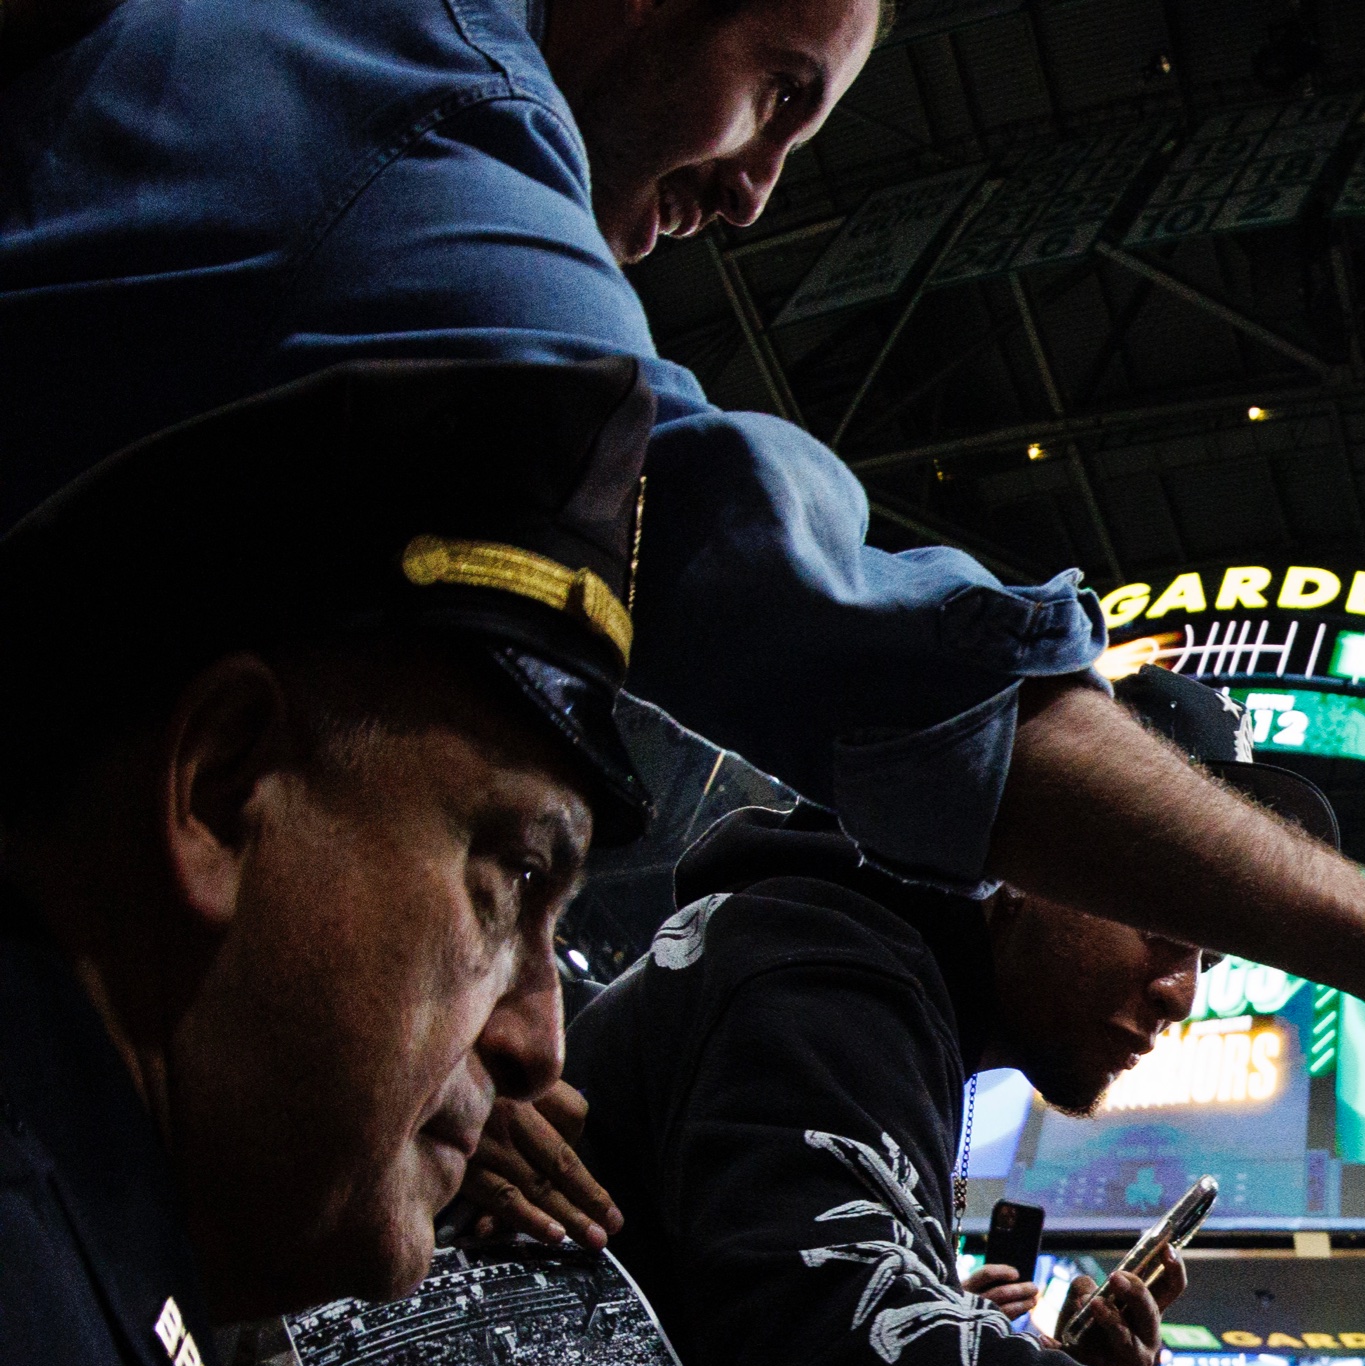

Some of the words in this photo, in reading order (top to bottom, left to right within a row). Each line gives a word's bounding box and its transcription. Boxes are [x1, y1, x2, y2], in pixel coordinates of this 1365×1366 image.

[1142, 203, 1206, 240] 10
[1236, 189, 1280, 222] 2
[1040, 226, 1077, 258] 6
